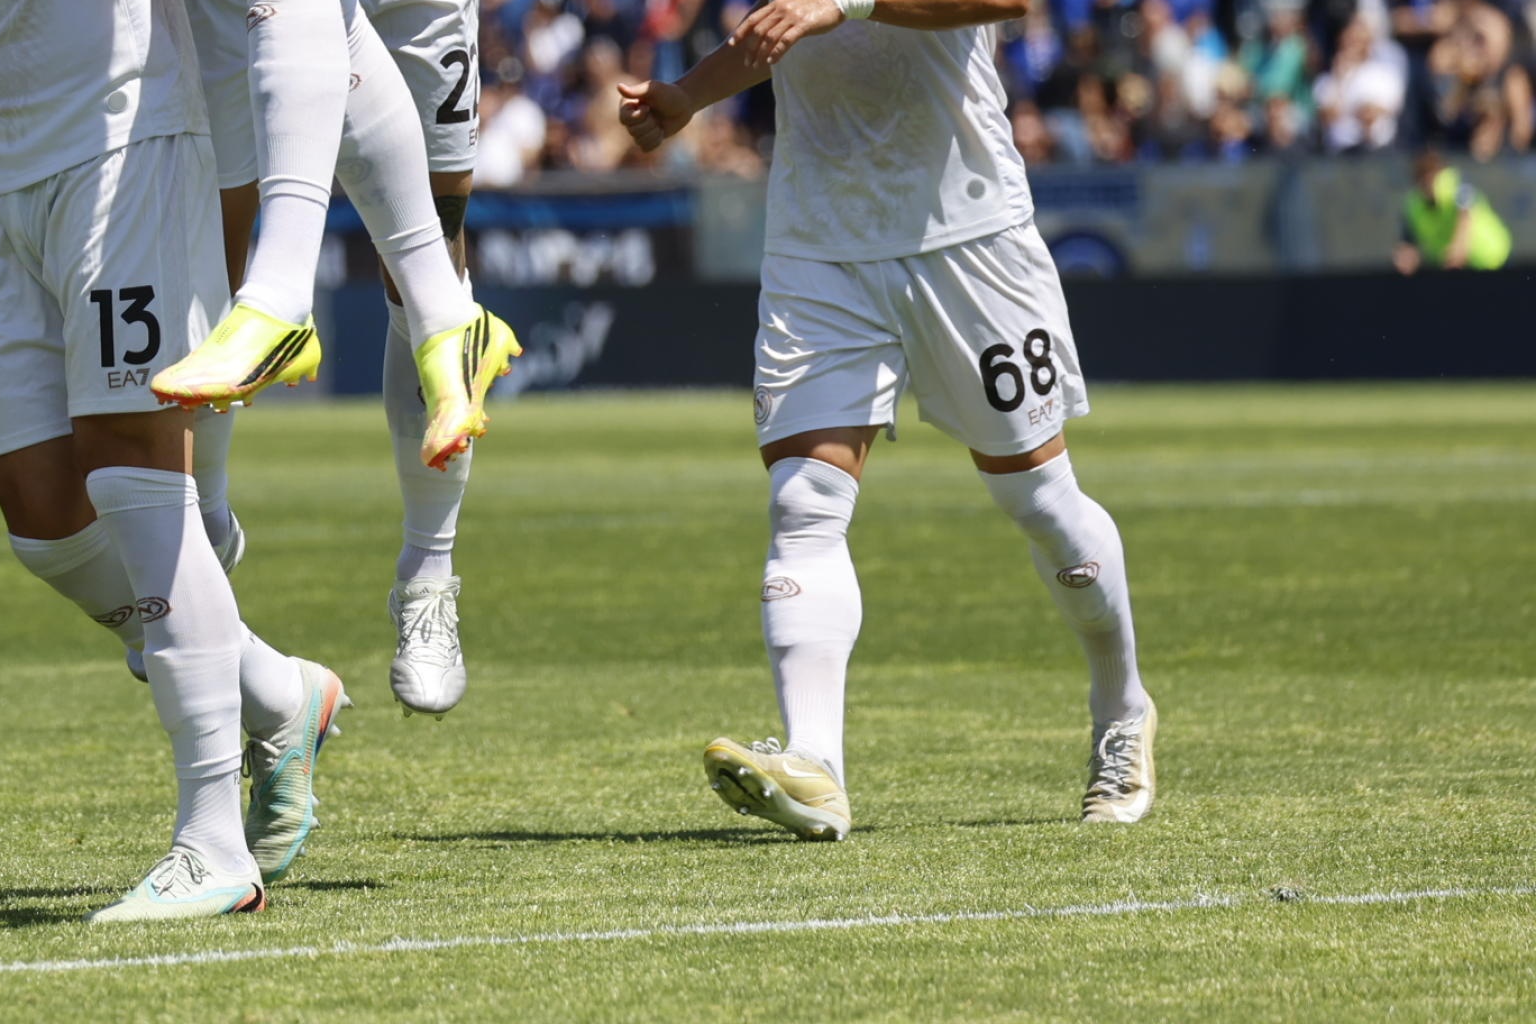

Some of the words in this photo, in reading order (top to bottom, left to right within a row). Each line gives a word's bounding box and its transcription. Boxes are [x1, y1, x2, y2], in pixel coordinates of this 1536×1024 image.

[90, 284, 162, 368] 13
[107, 368, 151, 389] EA7
[978, 328, 1057, 413] 68
[1027, 398, 1055, 426] EA7
